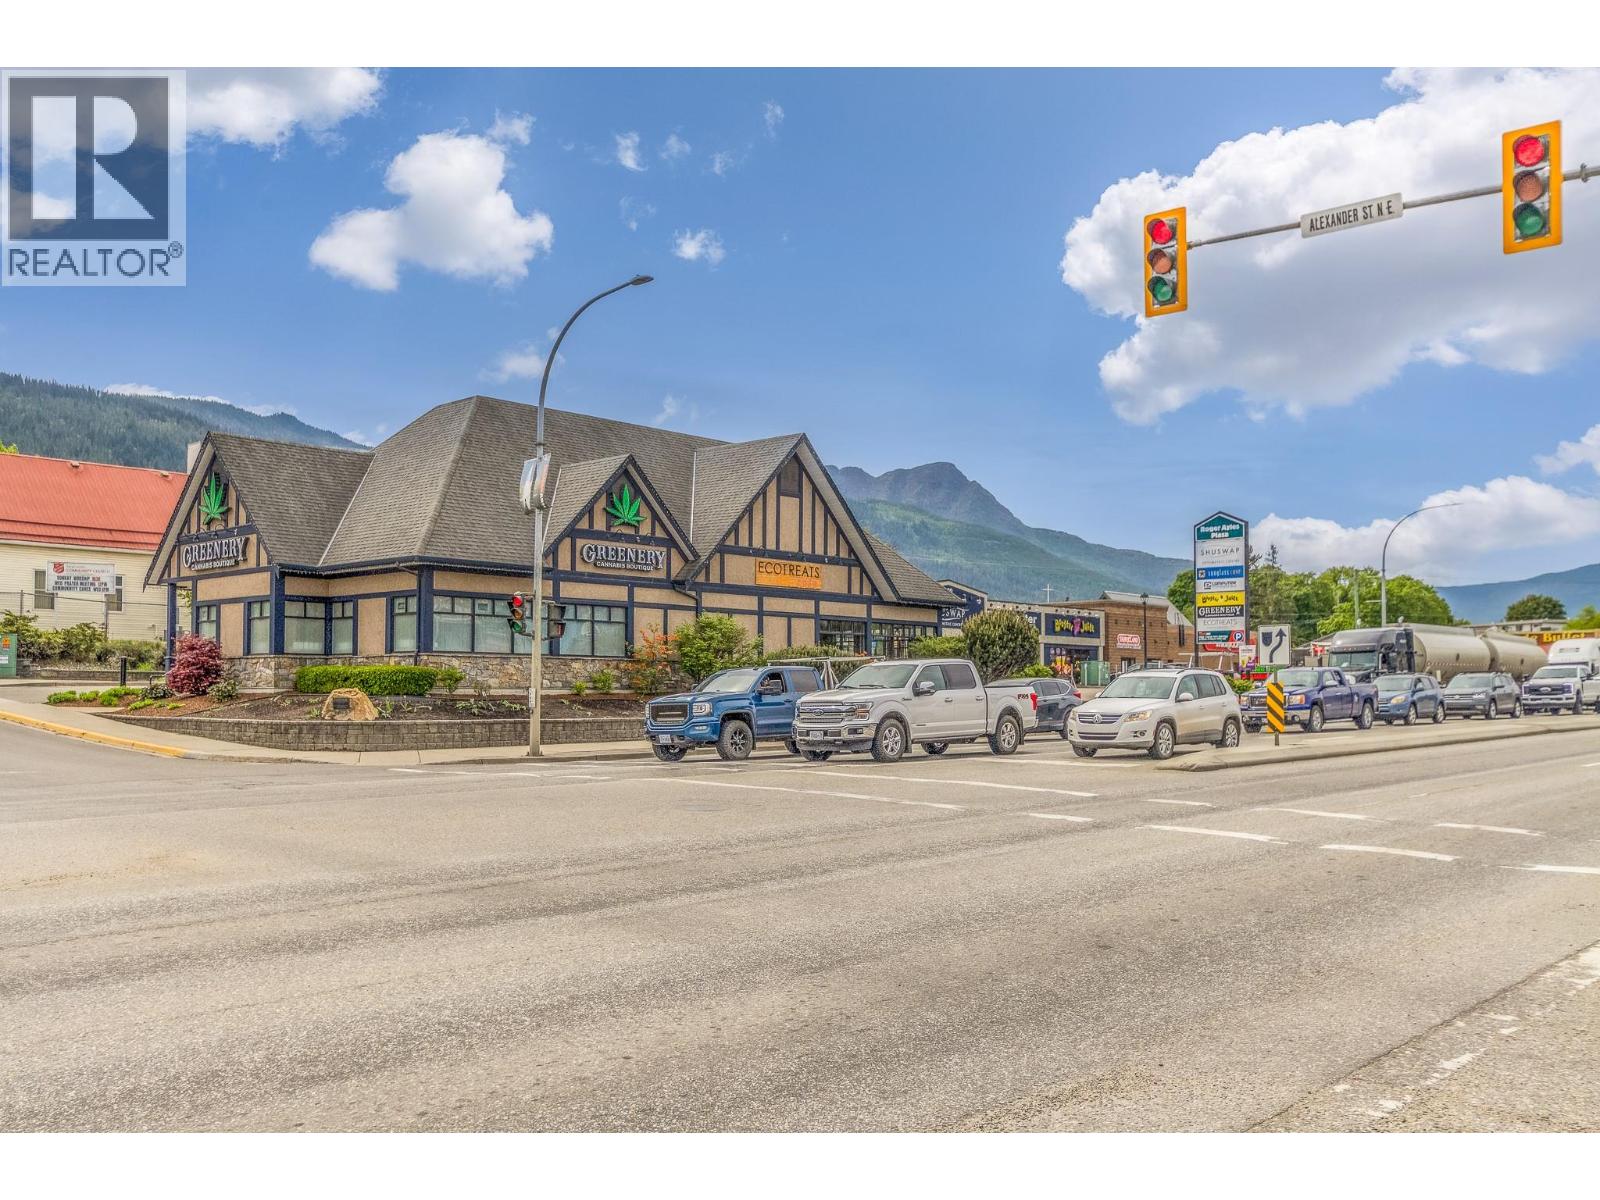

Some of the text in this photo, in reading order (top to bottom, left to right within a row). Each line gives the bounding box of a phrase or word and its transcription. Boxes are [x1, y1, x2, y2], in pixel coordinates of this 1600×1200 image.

[1309, 208, 1359, 232] ALEXANDER
[1363, 204, 1375, 220] ST
[1377, 202, 1384, 216] N
[182, 537, 246, 568] GREENERY
[582, 544, 666, 569] GREENERY
[1200, 547, 1240, 556] SHUSWAP
[596, 561, 654, 571] CANNABIS BOUTIQUE
[758, 561, 820, 578] ECOTREATS
[1198, 606, 1241, 617] GREENERY
